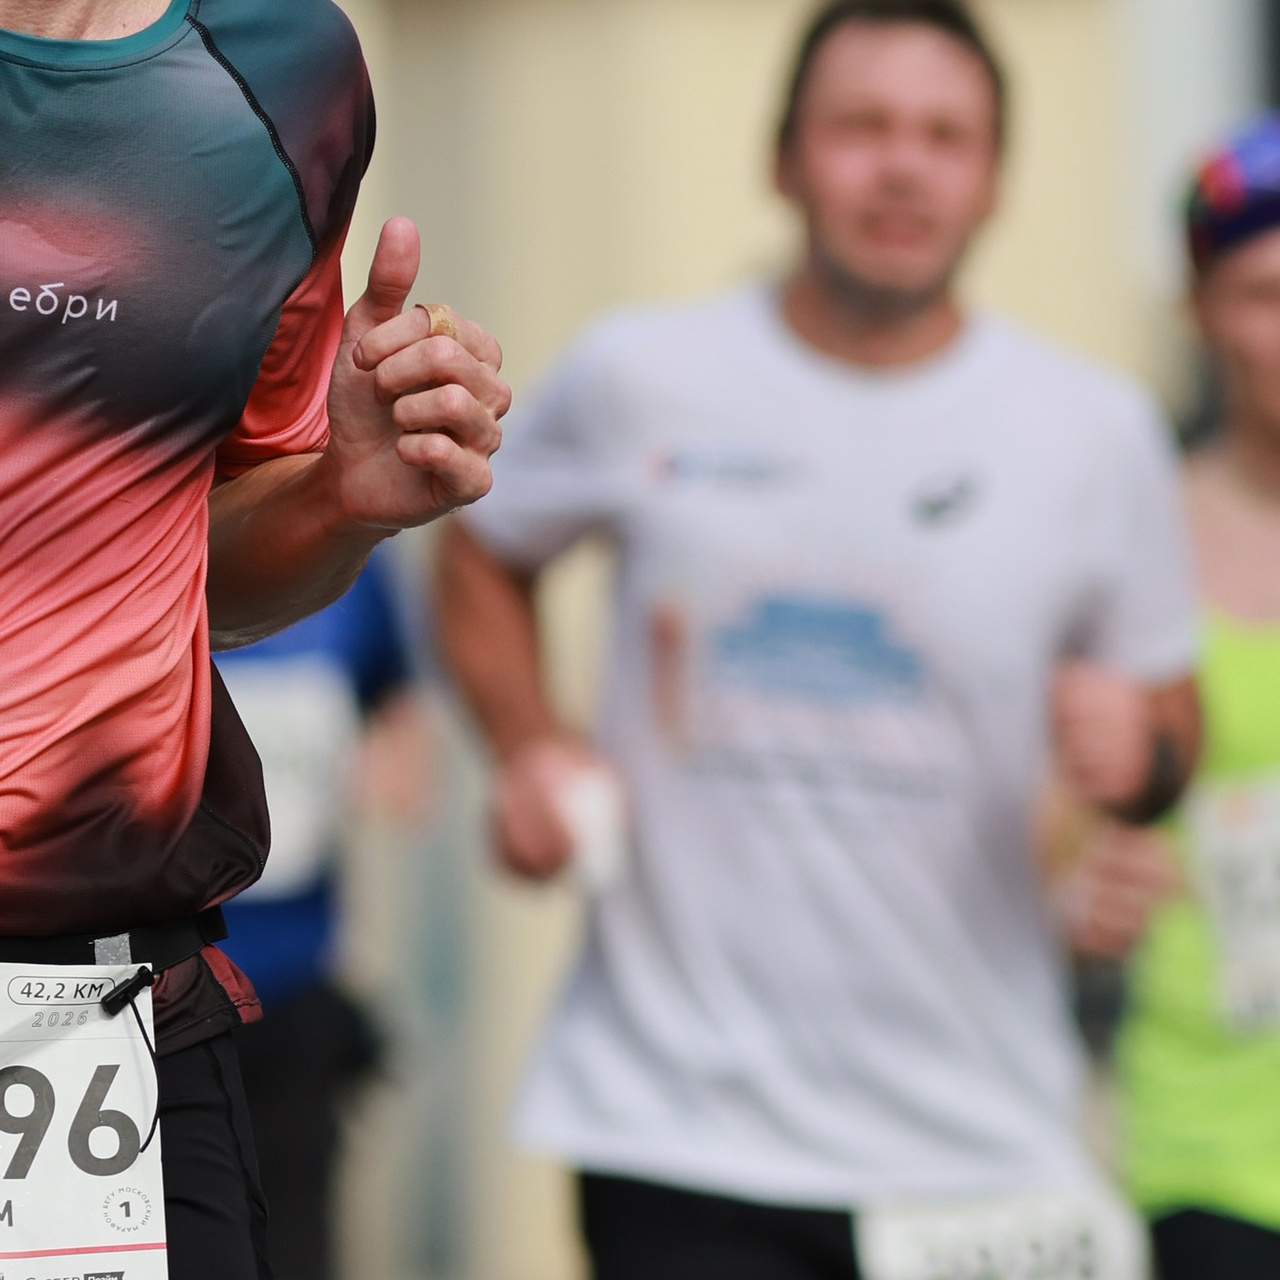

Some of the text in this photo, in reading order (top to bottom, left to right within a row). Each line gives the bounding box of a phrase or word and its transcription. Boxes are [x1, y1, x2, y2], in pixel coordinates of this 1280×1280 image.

[20, 982, 105, 1002] 42,2 КМ
[119, 1201, 131, 1218] 1
